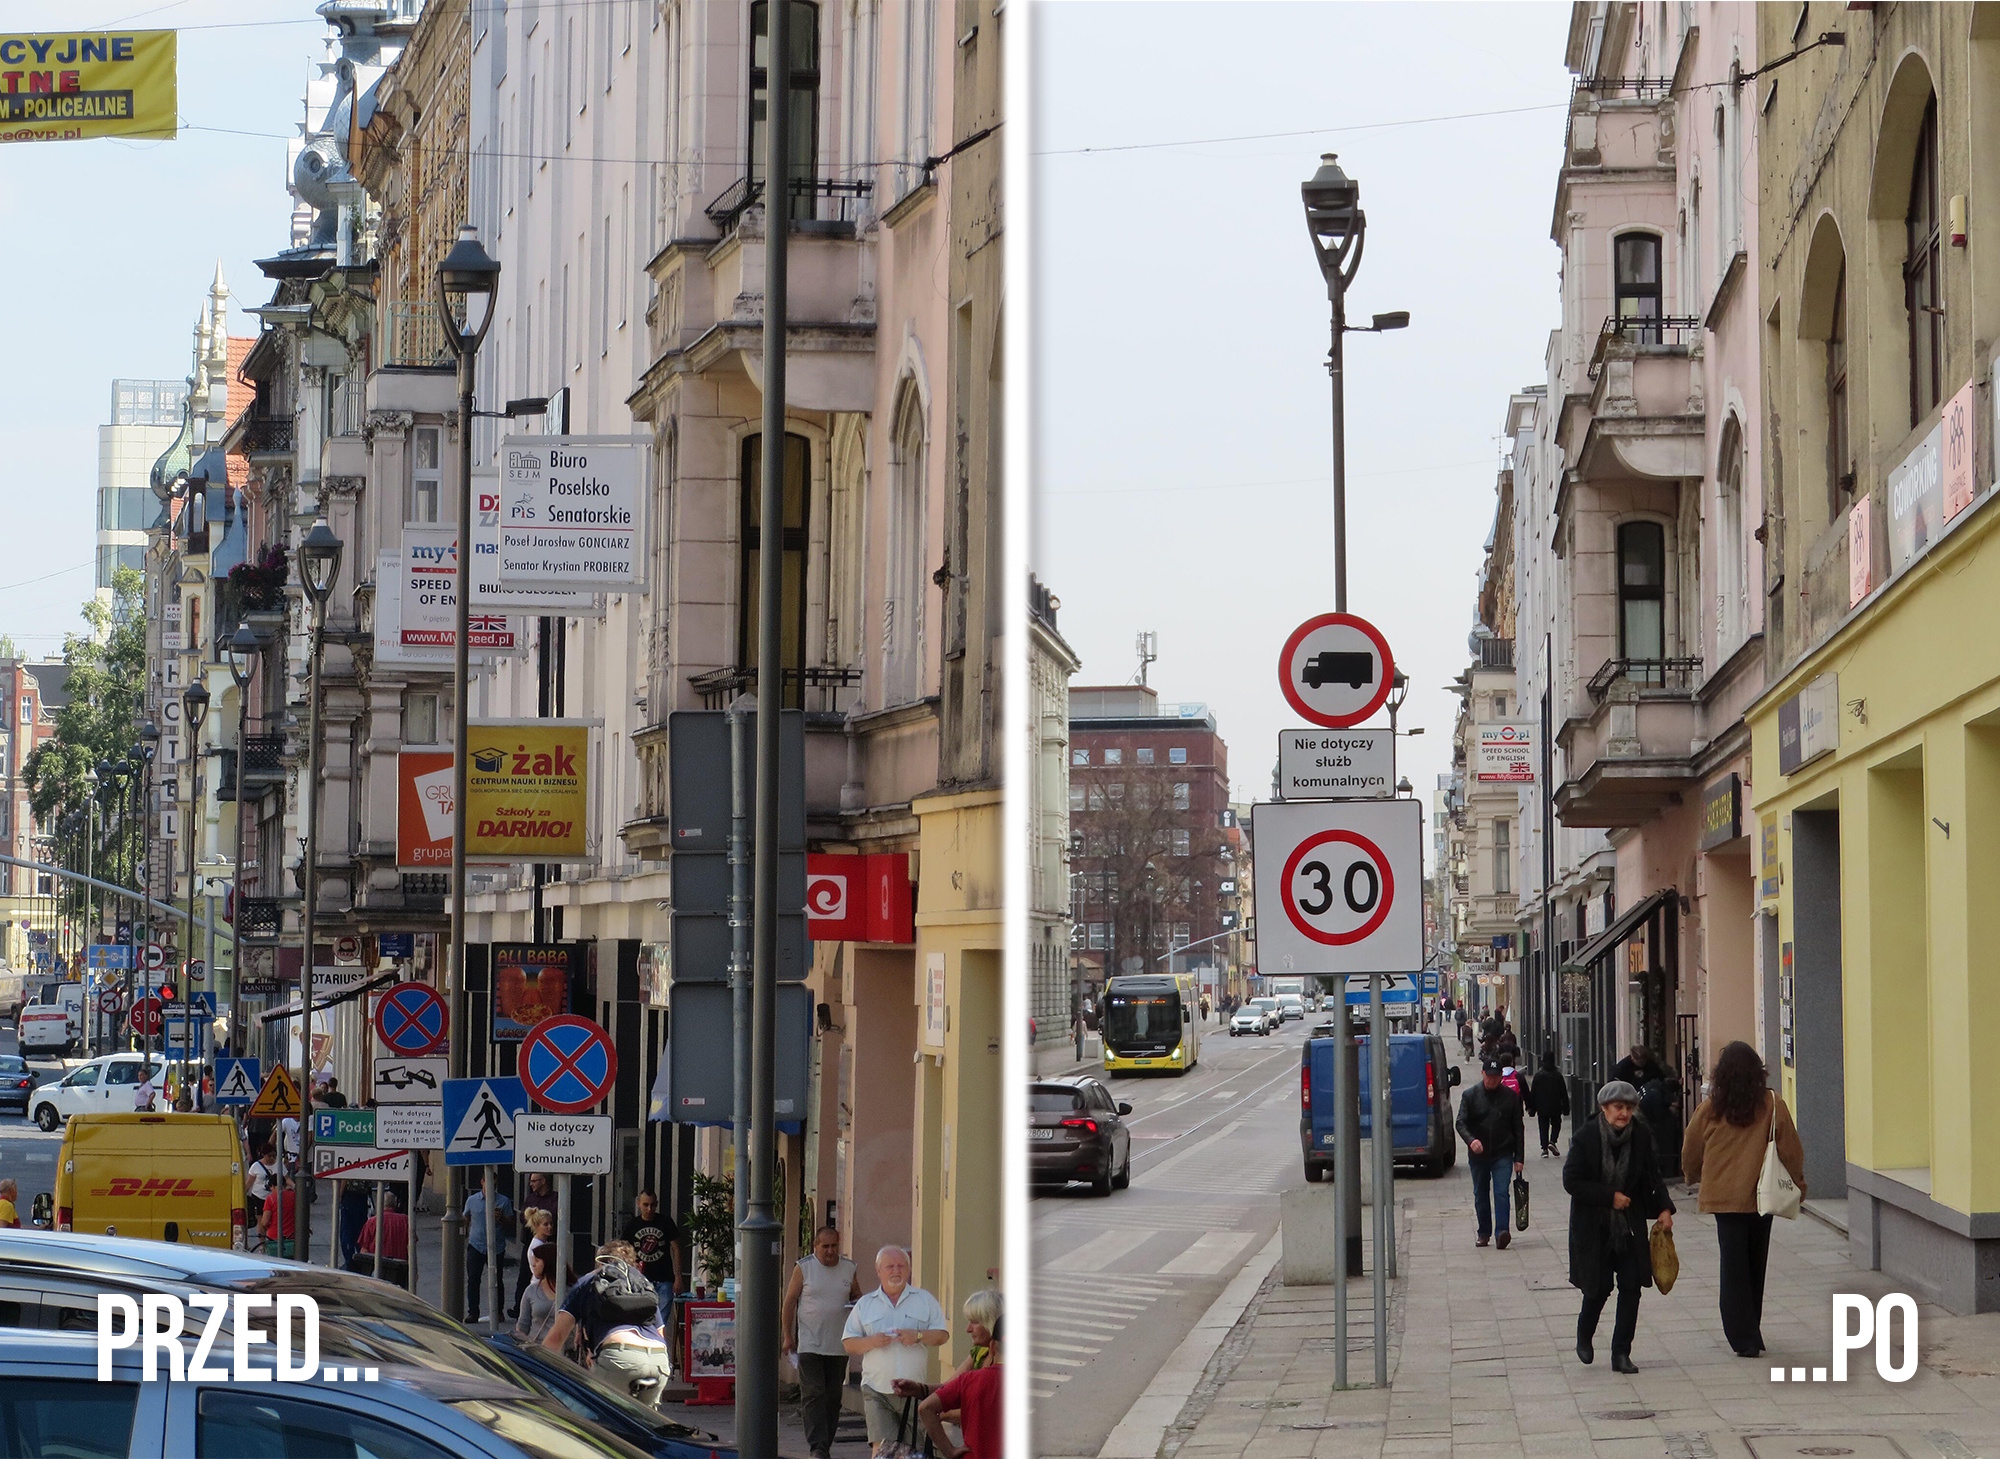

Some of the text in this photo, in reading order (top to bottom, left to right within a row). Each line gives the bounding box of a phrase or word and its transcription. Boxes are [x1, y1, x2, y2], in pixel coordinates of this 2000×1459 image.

[0, 37, 134, 64] CYJNE
[0, 70, 81, 94] TNE
[24, 96, 127, 119] POLICEALNE
[0, 127, 82, 142] e@vp.pl
[550, 450, 588, 469] Biuro
[509, 470, 541, 479] SEJM
[549, 477, 610, 496] Poselsko
[1893, 446, 1938, 521] COWORKING
[511, 506, 536, 519] PiS
[548, 504, 631, 524] Senatorskie
[504, 535, 630, 549] Poseł Jarosław GONCIARZ
[504, 559, 630, 574] Senator Krystian PROBIERZ
[411, 579, 452, 590] SPEED
[420, 594, 437, 605] OF
[429, 615, 451, 624] piętro
[406, 632, 510, 646] www.Mypeed.pl
[1295, 738, 1374, 752] Nie dotyczy
[511, 744, 577, 776] żak
[1315, 755, 1352, 768] służb
[470, 777, 510, 785] CENTRUM
[496, 807, 535, 818] Szkoły
[476, 820, 573, 838] DARMO!
[1299, 860, 1379, 916] 30
[497, 948, 568, 964] ALI BABA
[192, 966, 203, 975] 20
[311, 973, 365, 985] OTARIUSZ
[134, 1010, 161, 1023] SO
[407, 1110, 432, 1118] dotyczy
[338, 1120, 374, 1133] Podst
[527, 1121, 595, 1134] Nie dotyczy
[544, 1137, 575, 1147] służb
[337, 1156, 398, 1171] Podstrefa
[525, 1153, 603, 1166] komunalnych
[107, 1178, 199, 1197] DHL
